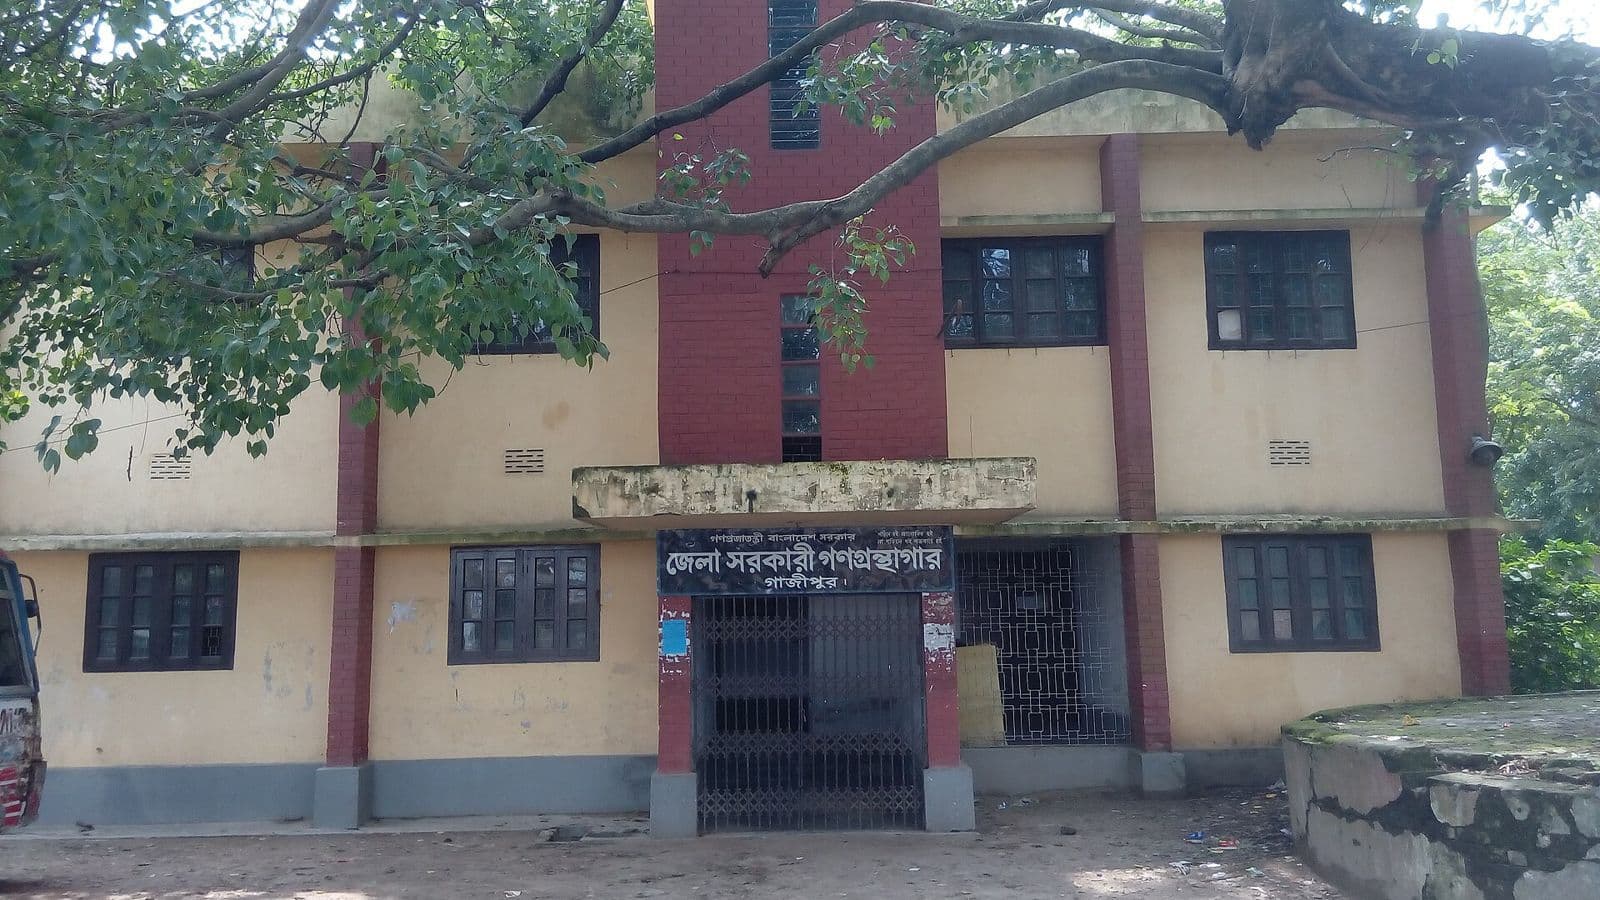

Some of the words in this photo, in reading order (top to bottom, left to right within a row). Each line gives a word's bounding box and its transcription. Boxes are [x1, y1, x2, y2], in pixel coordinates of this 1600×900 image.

[767, 534, 815, 542] বাংলাদেশ
[819, 533, 856, 542] সরকার
[666, 548, 720, 575] জেলা
[726, 542, 814, 573] সরকারী
[818, 546, 941, 573] গণগ্রন্থাগার
